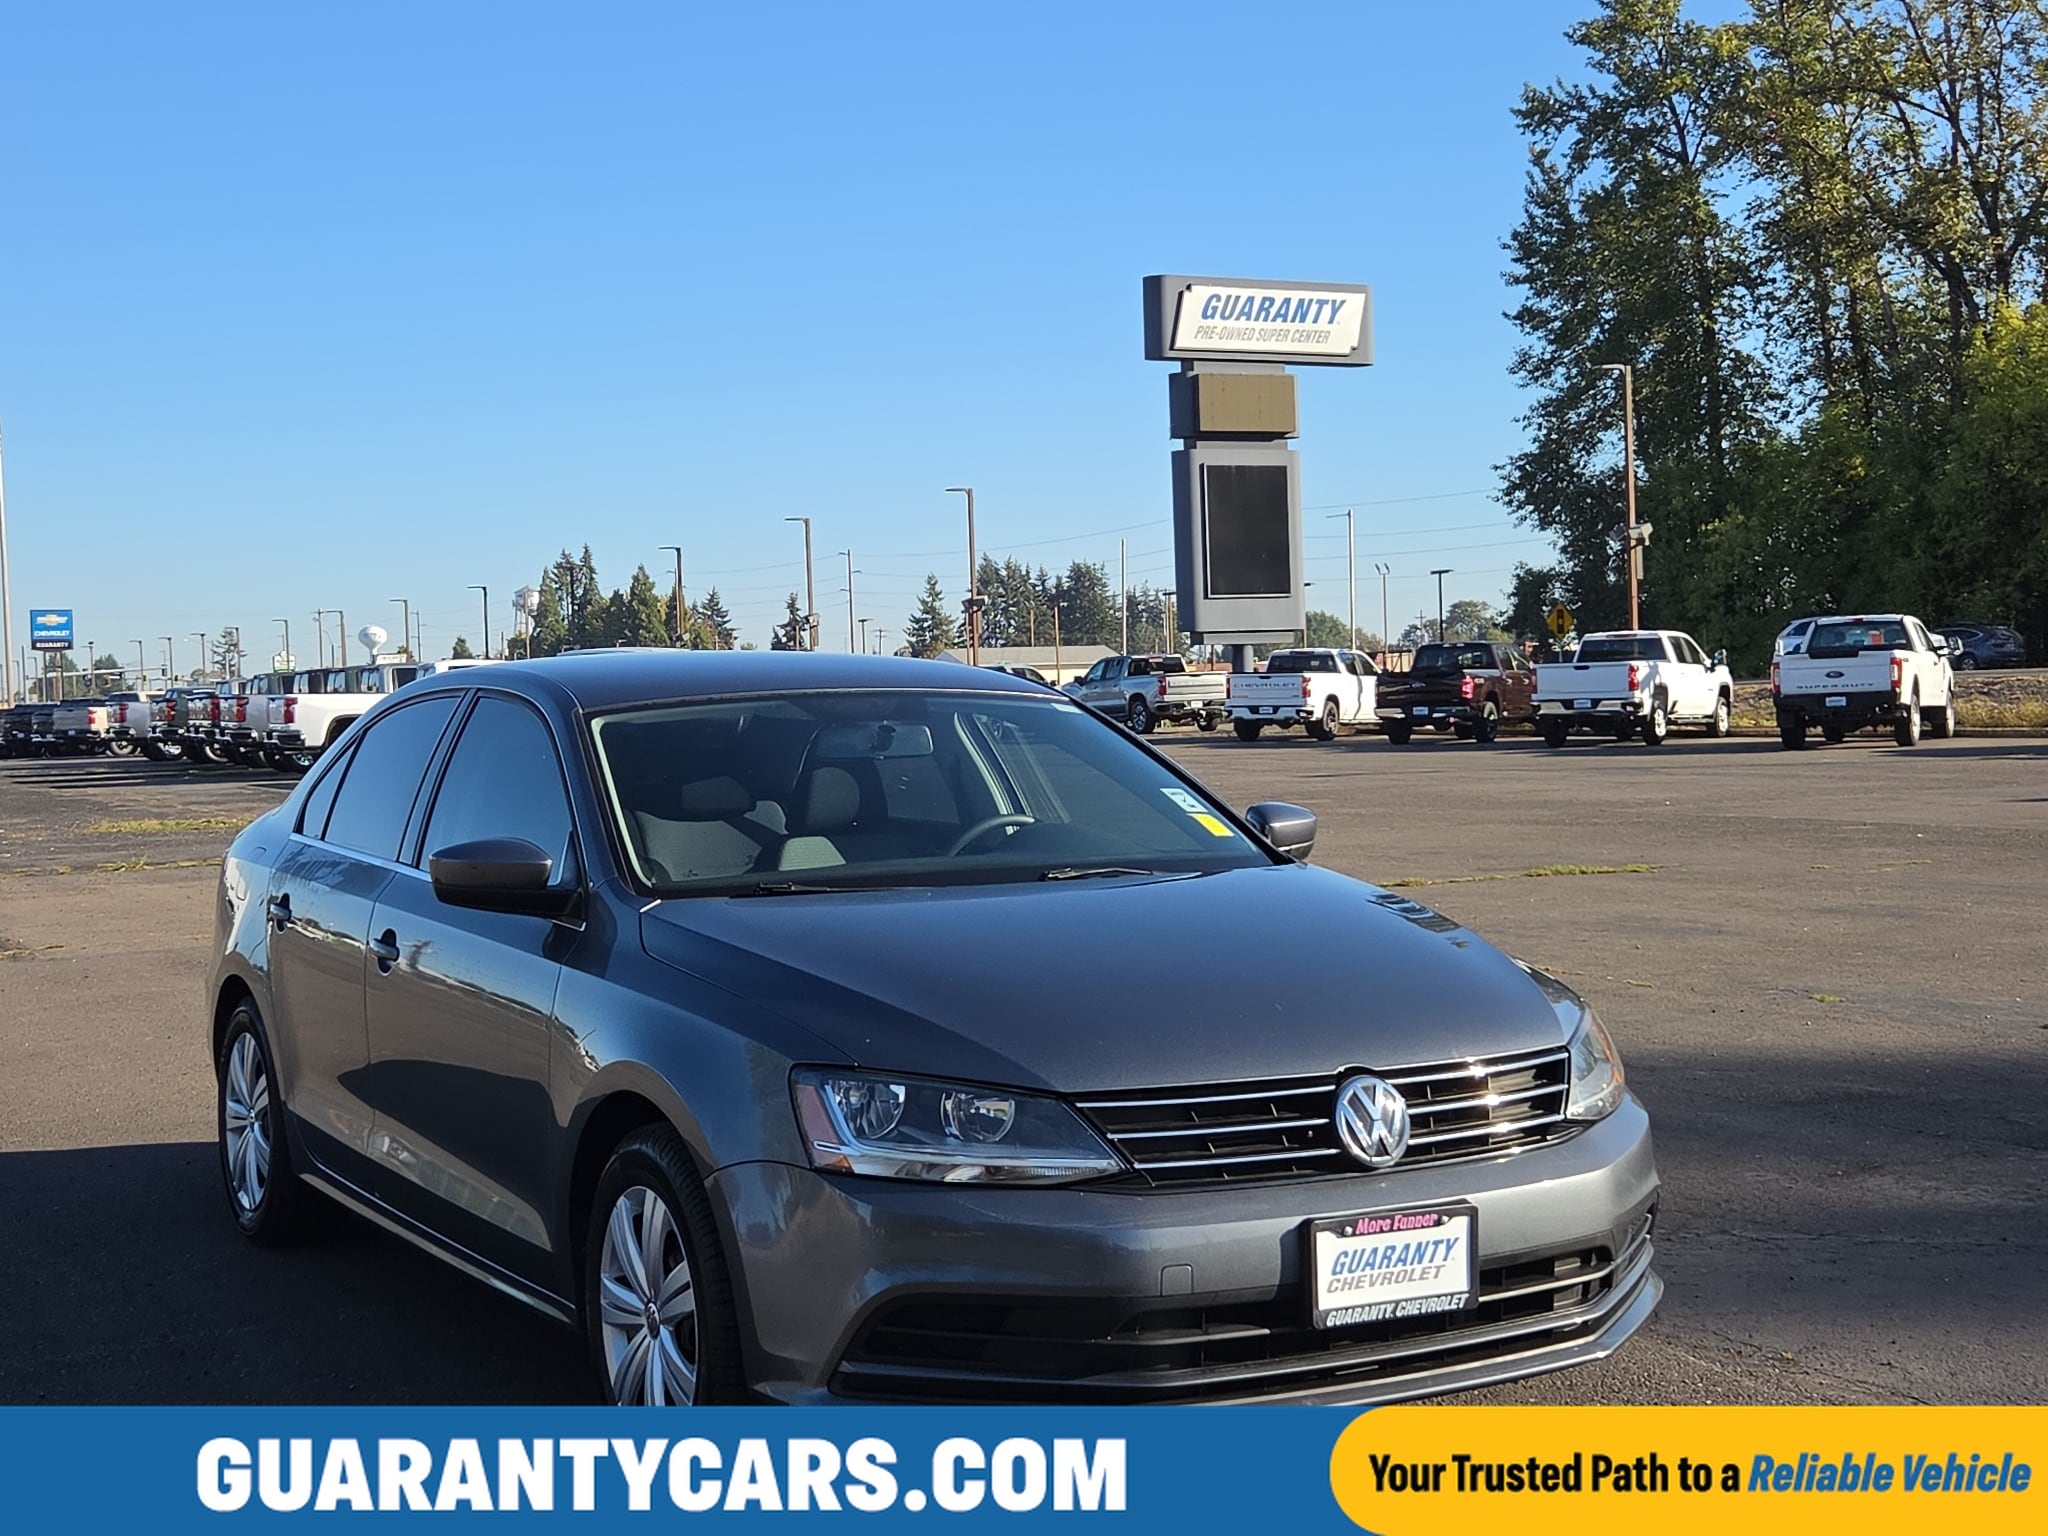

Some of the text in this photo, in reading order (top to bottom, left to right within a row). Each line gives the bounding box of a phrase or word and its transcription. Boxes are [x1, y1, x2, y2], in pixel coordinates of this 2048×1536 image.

[1201, 293, 1346, 325] GUARANTY
[1194, 325, 1331, 344] PRE-OWNED SUPER CENTER
[1355, 1218, 1391, 1234] More
[1331, 1237, 1460, 1276] GUARANTY
[1326, 1265, 1446, 1294] CHEVROLET
[1395, 1294, 1469, 1315] CHEVROLET
